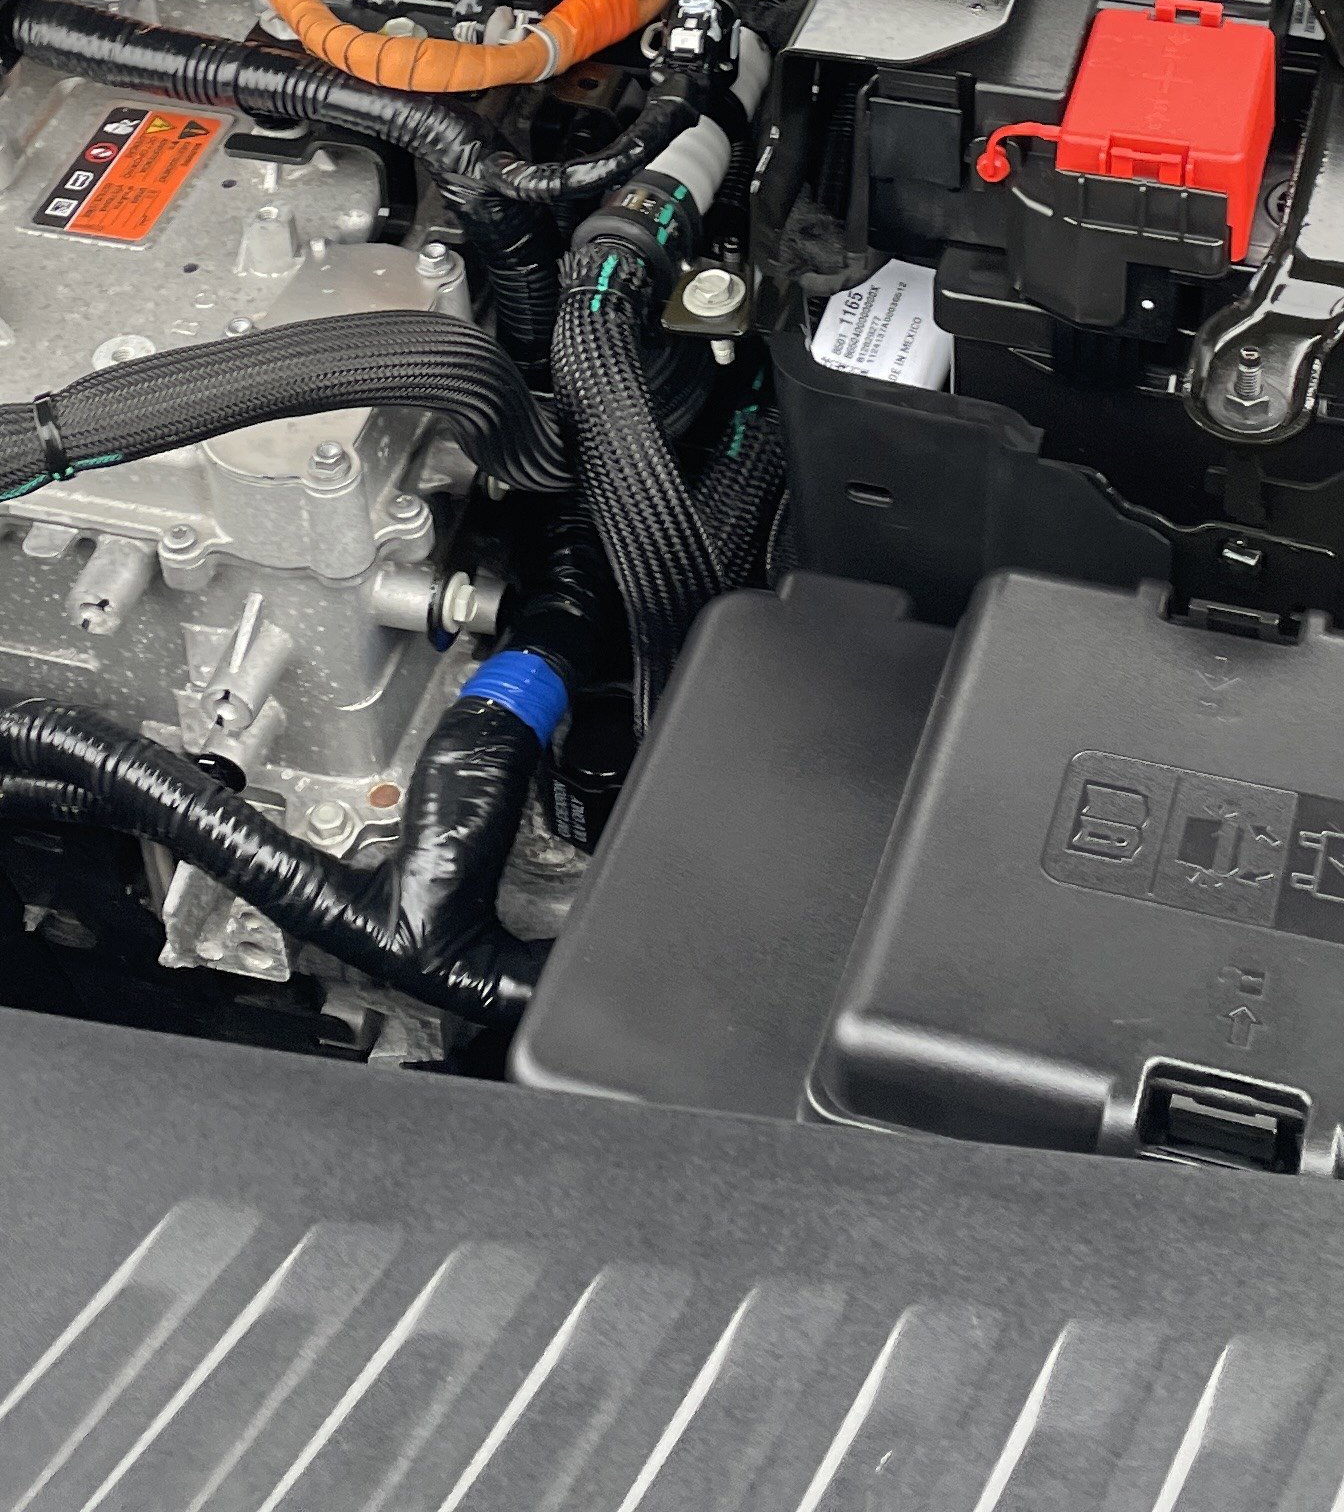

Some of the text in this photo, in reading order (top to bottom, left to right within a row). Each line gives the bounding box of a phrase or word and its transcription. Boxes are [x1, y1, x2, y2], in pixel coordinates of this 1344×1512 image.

[839, 291, 863, 325] 1165
[900, 316, 922, 354] MEXICO
[894, 355, 907, 367] IN
